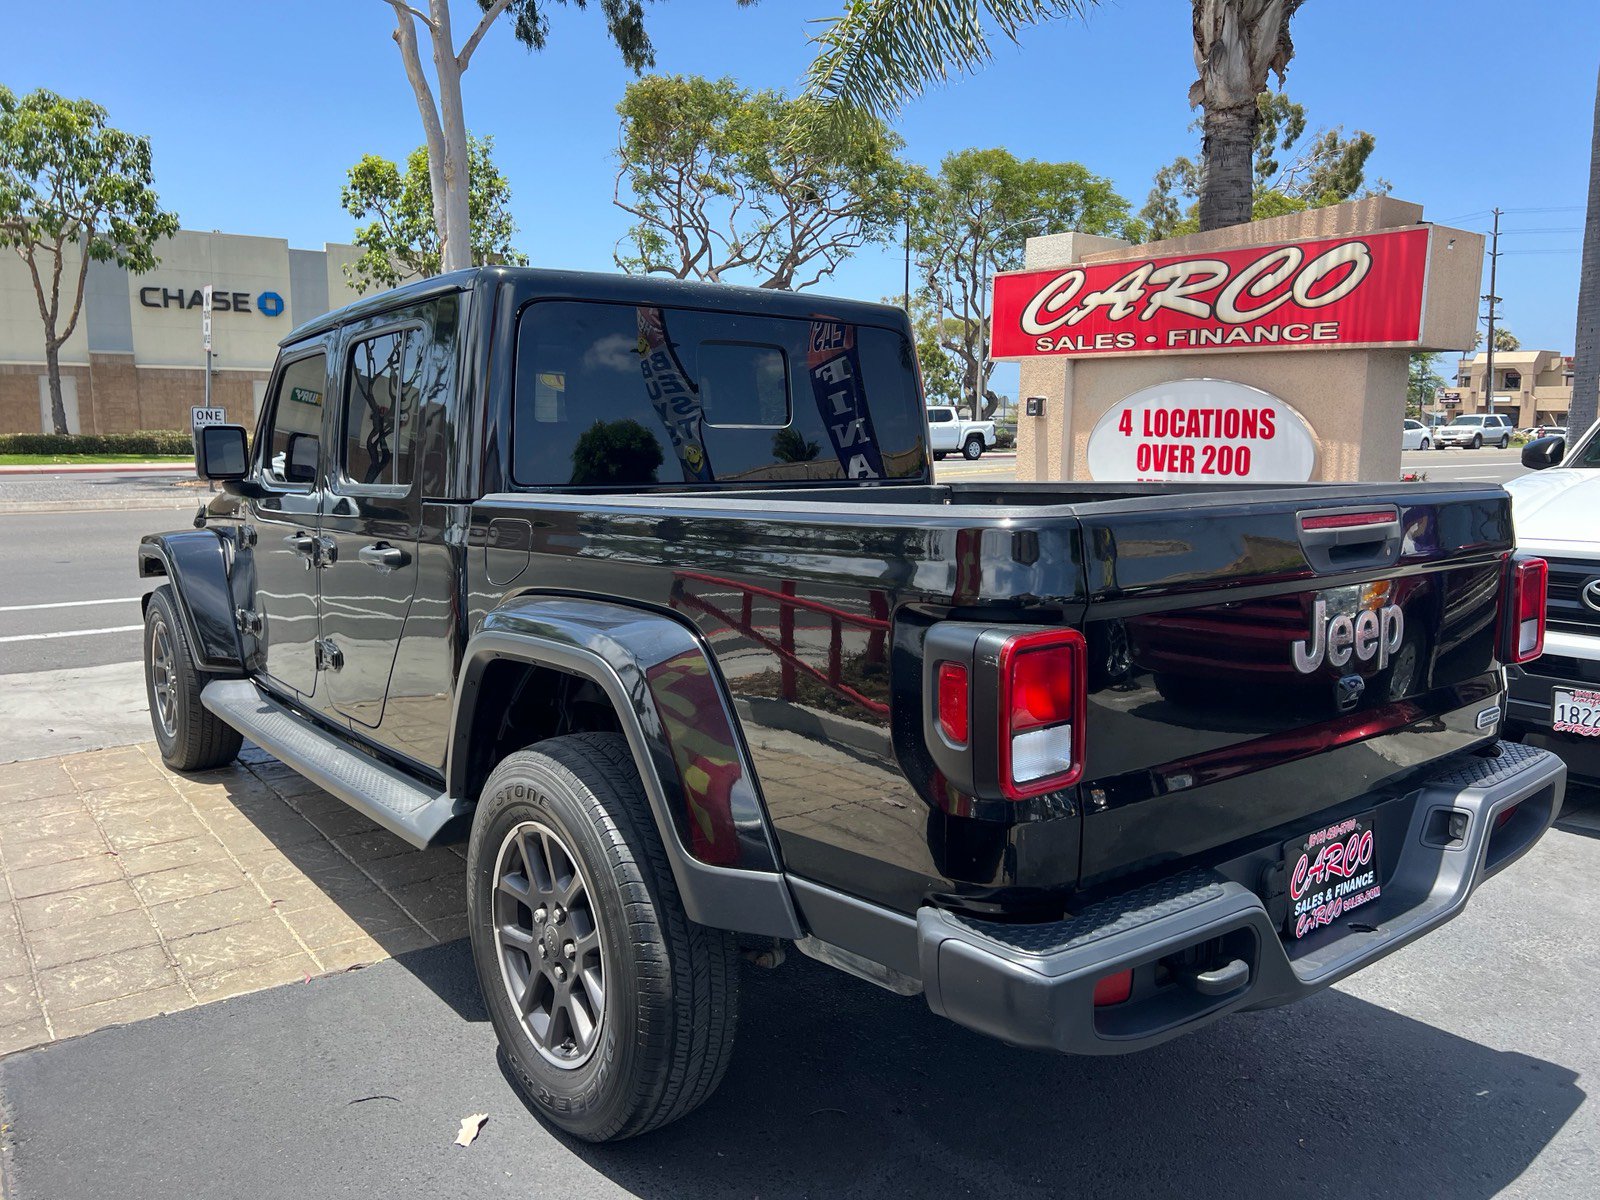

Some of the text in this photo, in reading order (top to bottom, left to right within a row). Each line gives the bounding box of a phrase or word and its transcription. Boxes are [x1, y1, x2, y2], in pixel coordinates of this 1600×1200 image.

[140, 287, 252, 313] CHASE
[1019, 240, 1374, 336] CARCO
[1035, 321, 1341, 352] SALES FINANCE
[196, 411, 222, 420] ONE
[1118, 408, 1276, 440] 4 LOCATIONS
[1136, 444, 1251, 477] OVER 200
[1291, 600, 1404, 674] Jeep
[1290, 830, 1374, 900] CARCO
[1294, 870, 1374, 917] SALES & FINANCE
